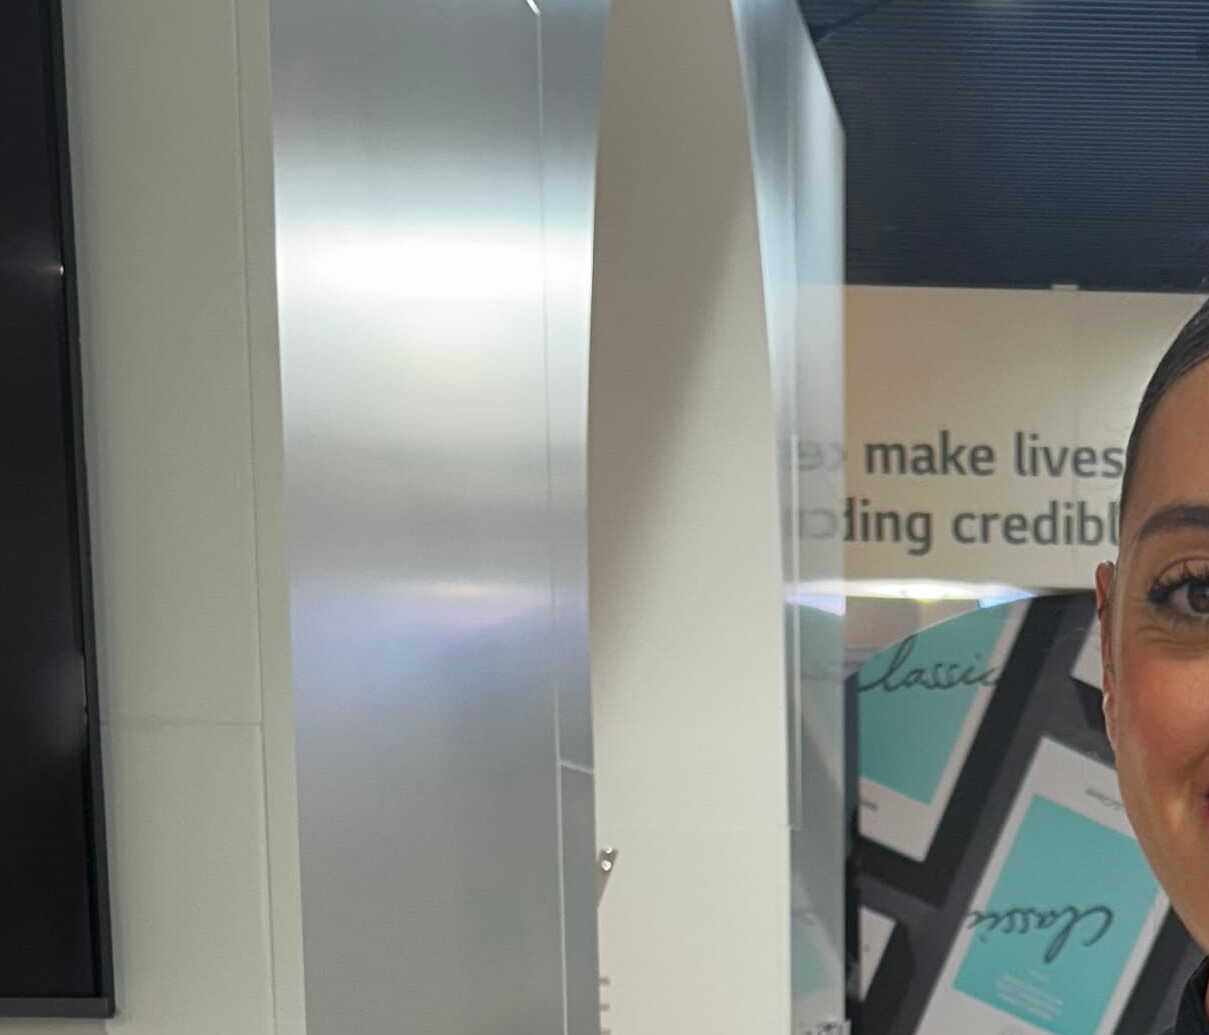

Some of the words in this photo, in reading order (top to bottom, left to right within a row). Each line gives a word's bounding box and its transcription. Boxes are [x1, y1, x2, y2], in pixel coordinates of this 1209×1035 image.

[864, 430, 995, 476] make
[1014, 431, 1125, 478] lives
[857, 633, 998, 692] lassic
[965, 903, 1116, 965] Classic
